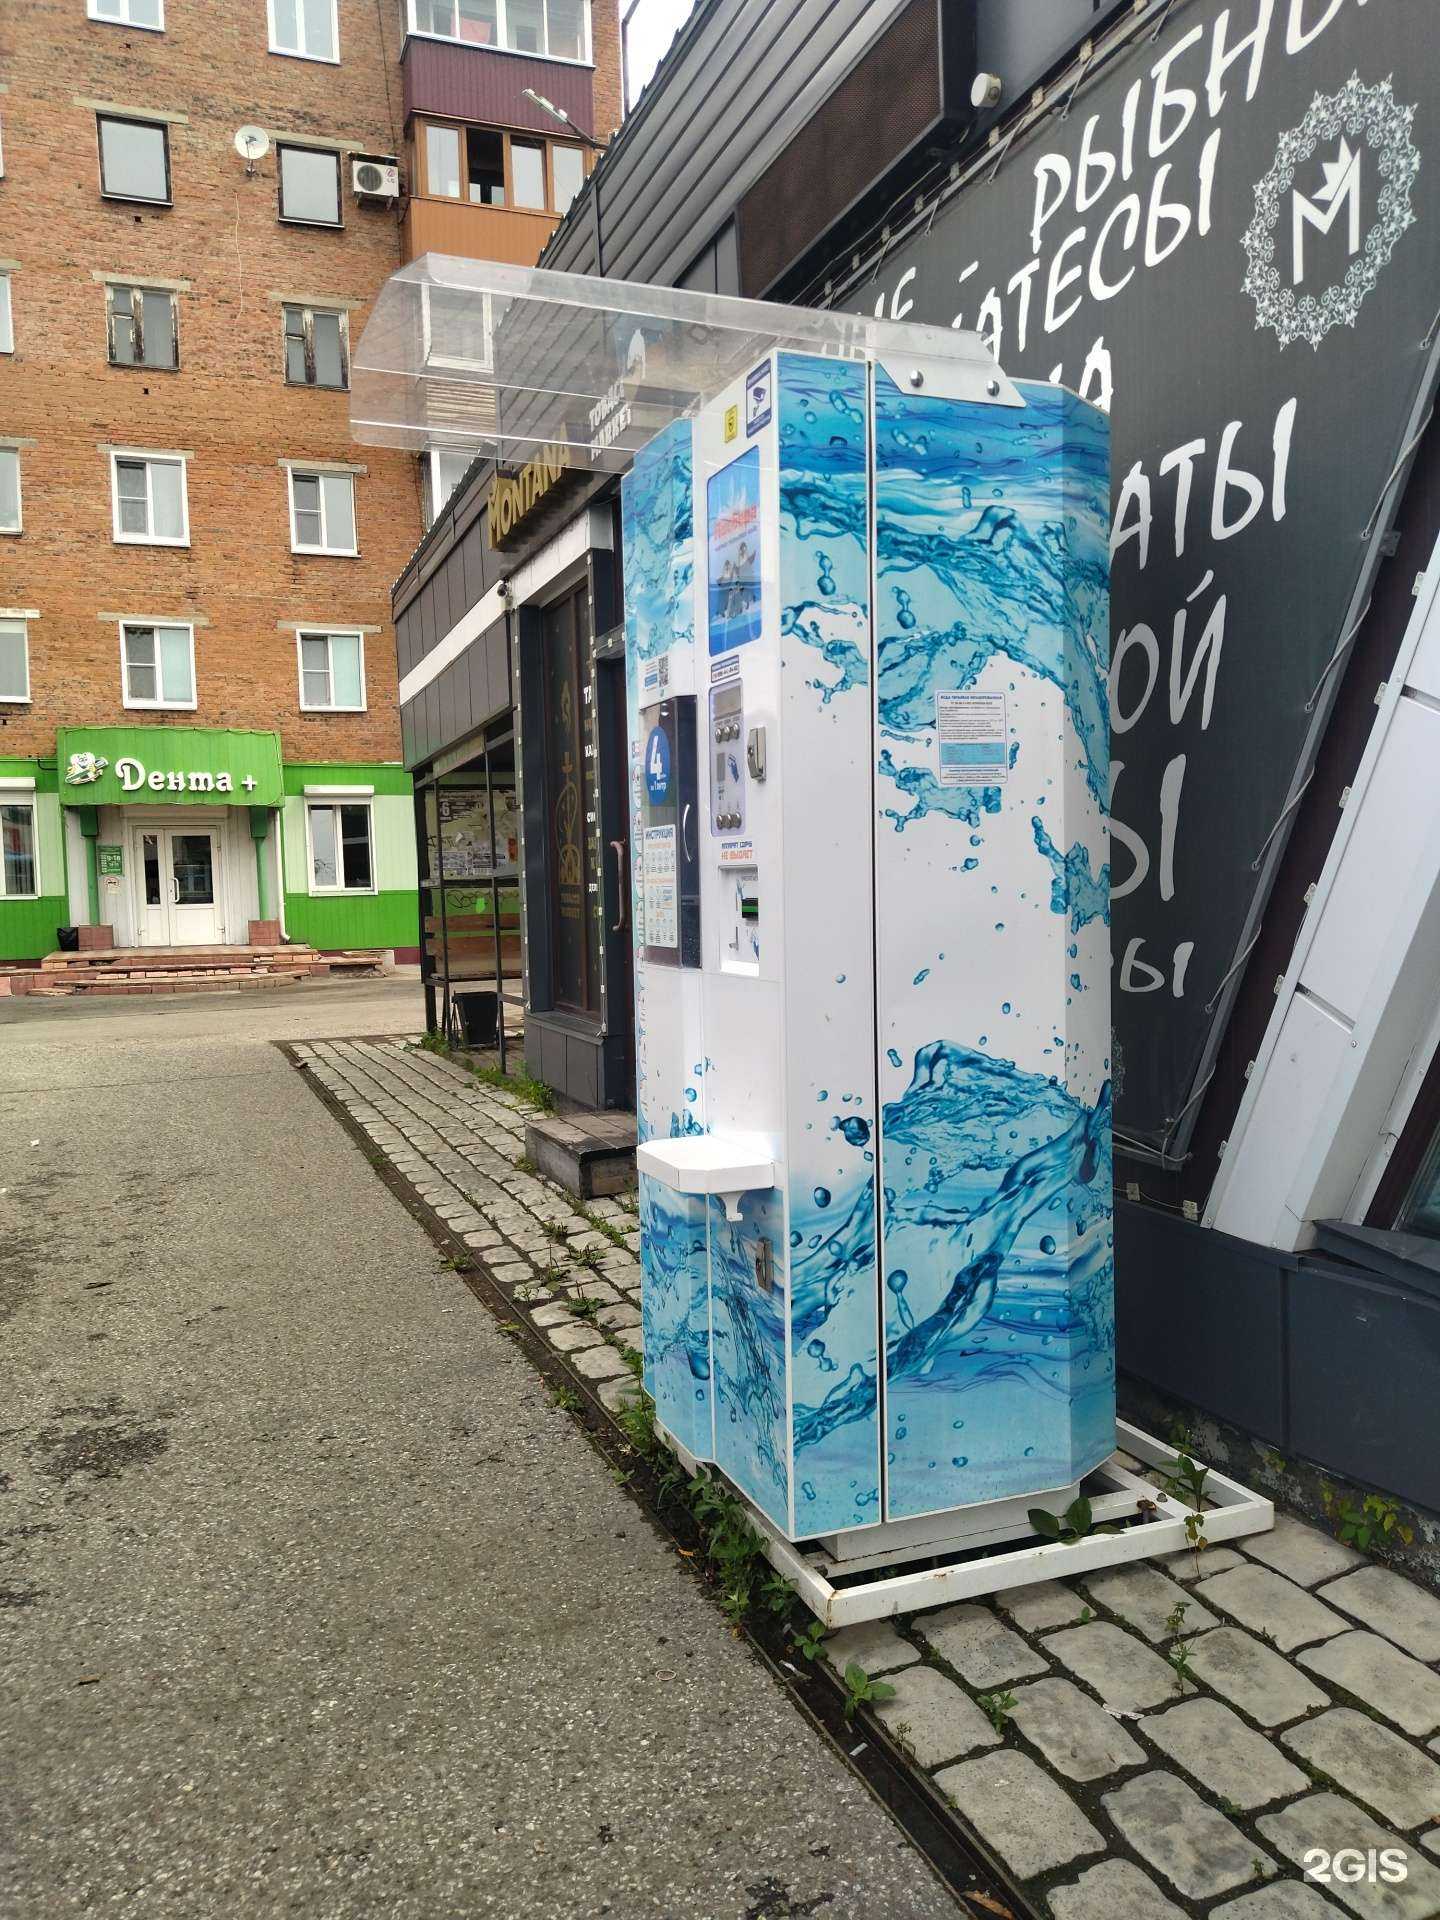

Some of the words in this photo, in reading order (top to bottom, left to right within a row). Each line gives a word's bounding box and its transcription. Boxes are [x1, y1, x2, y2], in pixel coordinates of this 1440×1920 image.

[590, 400, 632, 462] MARKET
[487, 420, 571, 552] MONTANA
[114, 757, 234, 792] Дента
